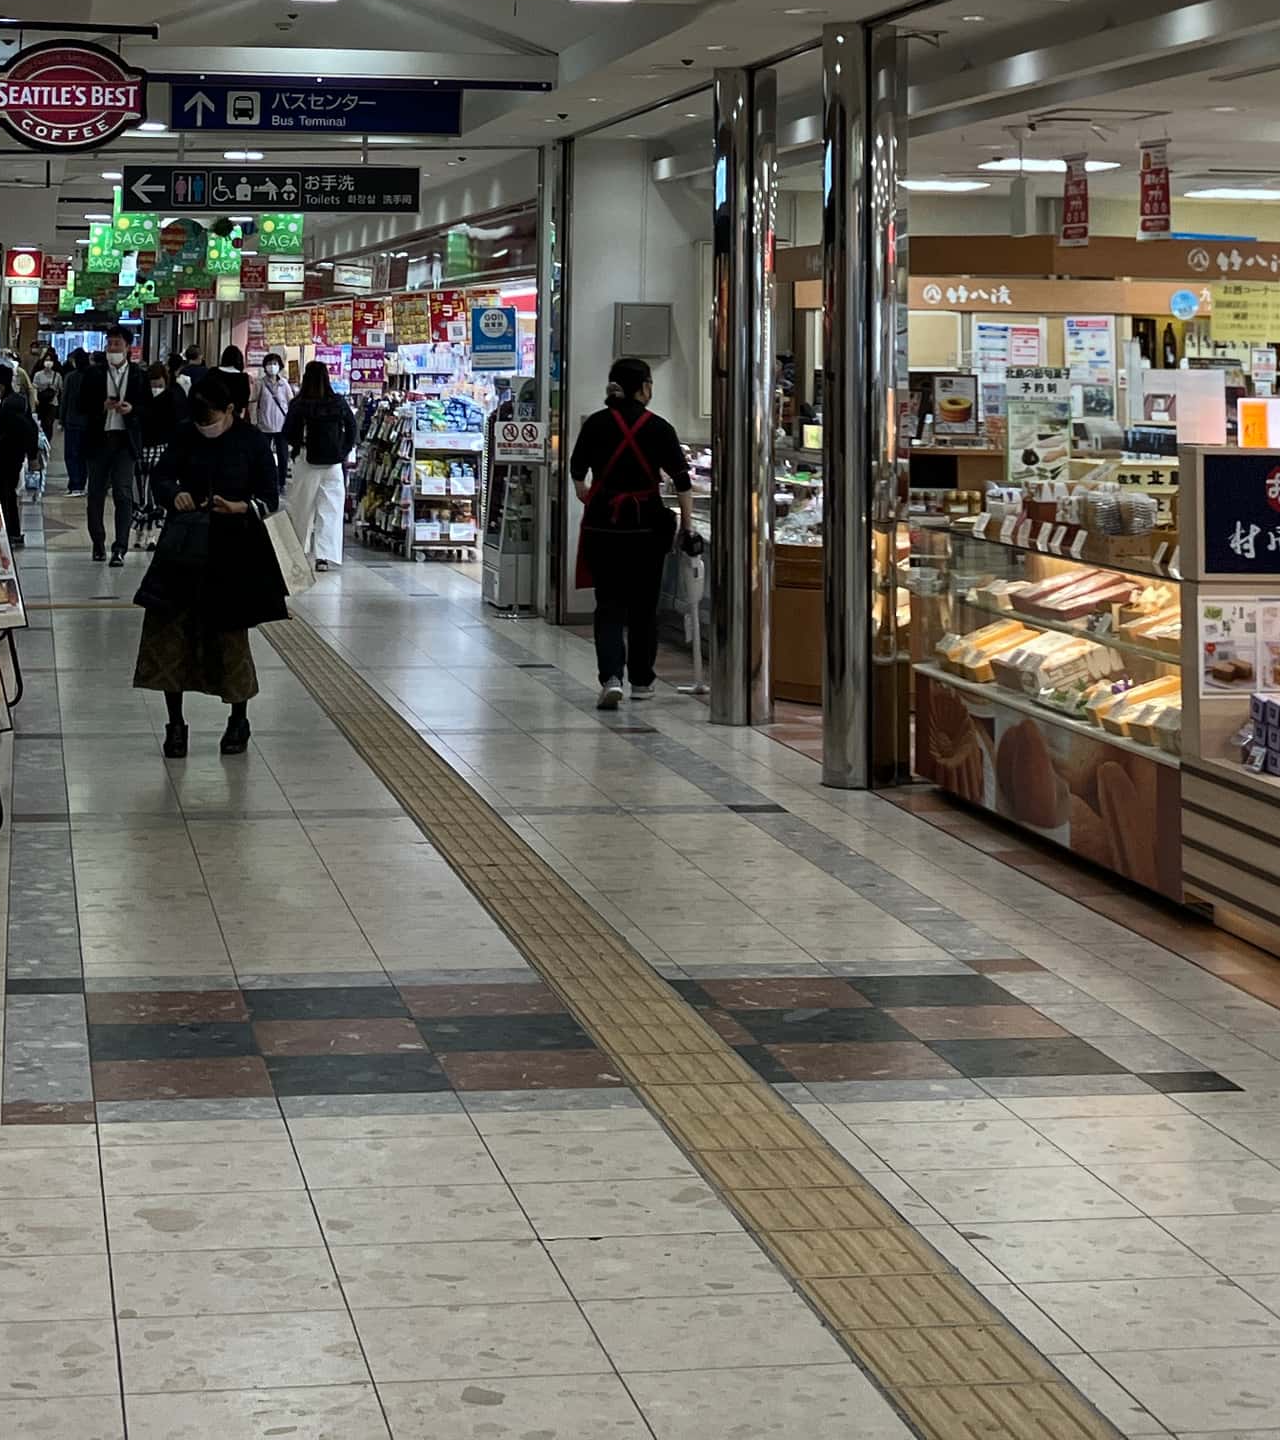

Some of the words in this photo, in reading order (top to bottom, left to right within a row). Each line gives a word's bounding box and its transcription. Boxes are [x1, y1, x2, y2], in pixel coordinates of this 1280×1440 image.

[91, 86, 138, 107] BEST
[271, 93, 376, 111] バスセンター
[272, 115, 294, 126] Bus
[299, 115, 346, 127] Terminal
[21, 119, 109, 140] COFFEE
[304, 175, 354, 191] お手洗
[304, 194, 340, 205] Toilets
[114, 232, 155, 245] SAGA
[260, 235, 300, 247] SAGA
[89, 258, 120, 268] SAGA
[208, 261, 239, 271] SAGA
